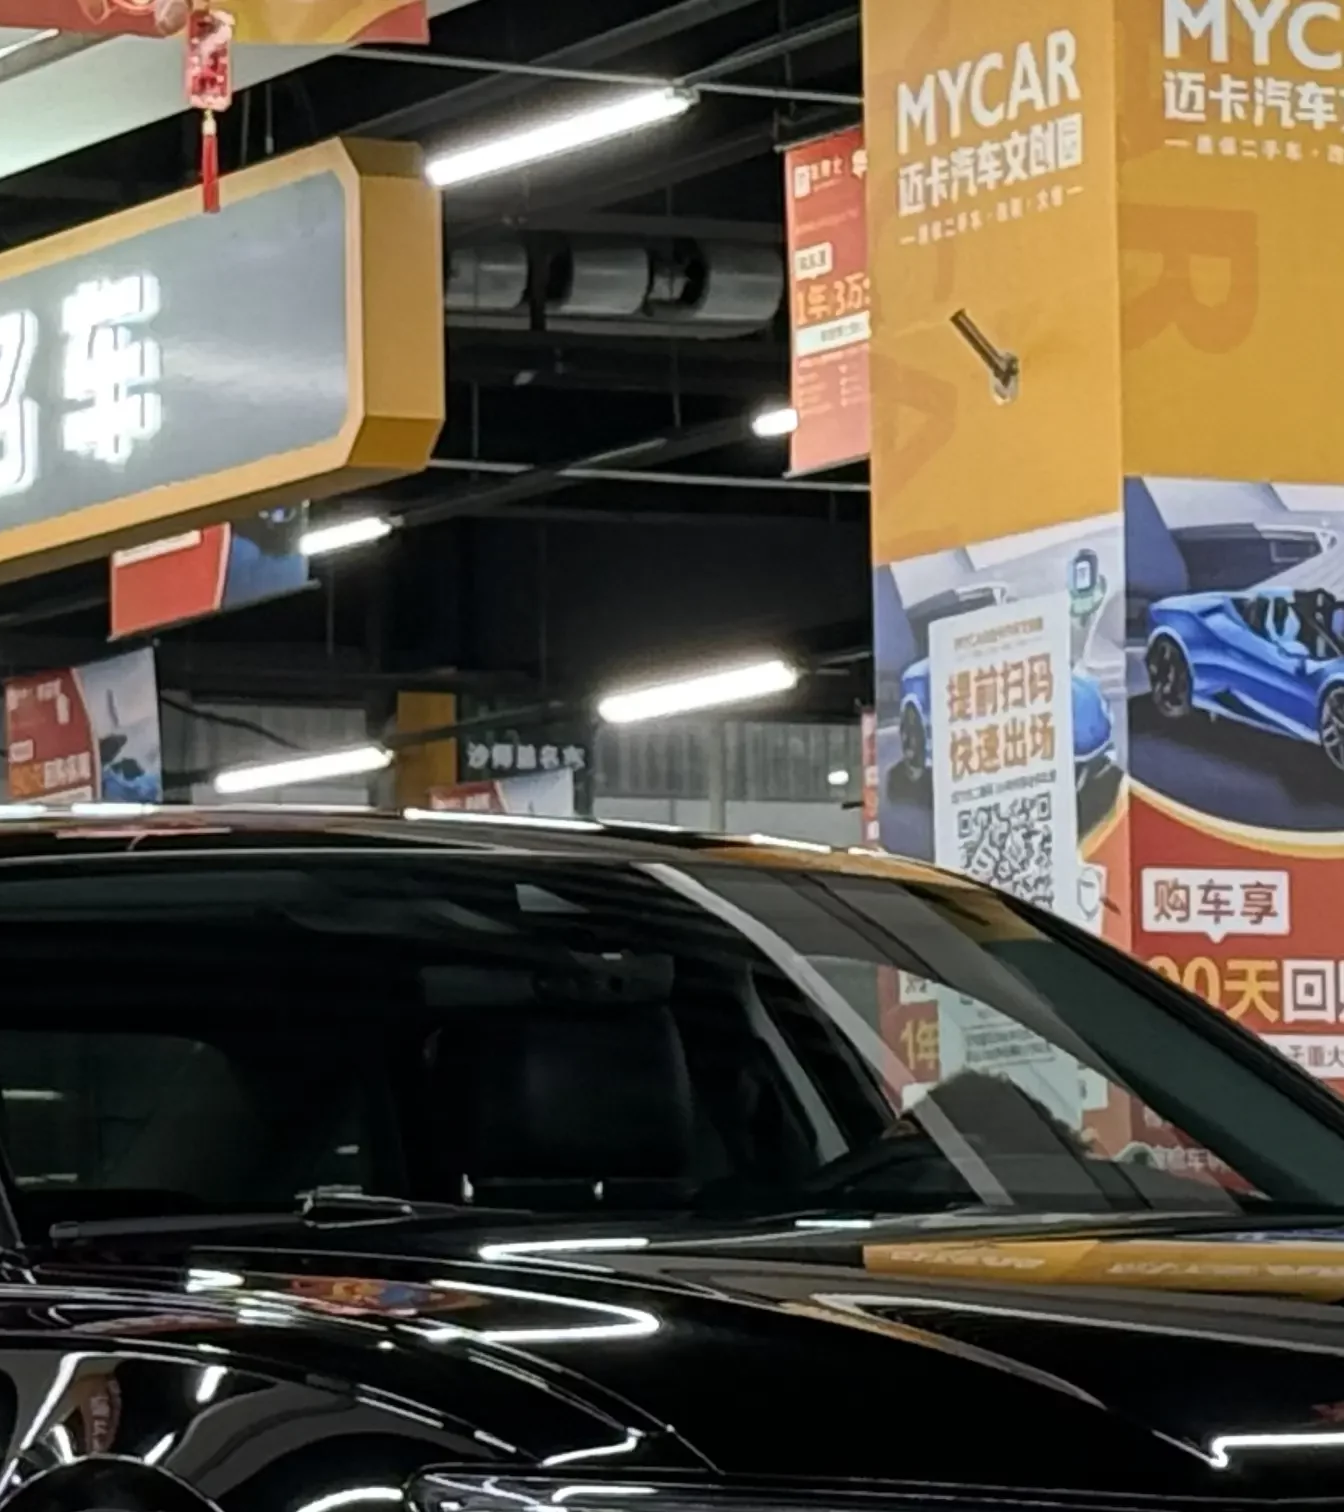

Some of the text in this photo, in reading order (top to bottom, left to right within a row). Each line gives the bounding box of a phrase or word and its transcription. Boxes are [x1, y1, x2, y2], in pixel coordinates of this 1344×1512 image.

[897, 30, 1082, 154] MYCAR
[898, 112, 1083, 217] 迈卡汽车文创园
[947, 653, 1054, 722] 提前扫码
[1153, 879, 1279, 925] 购车享
